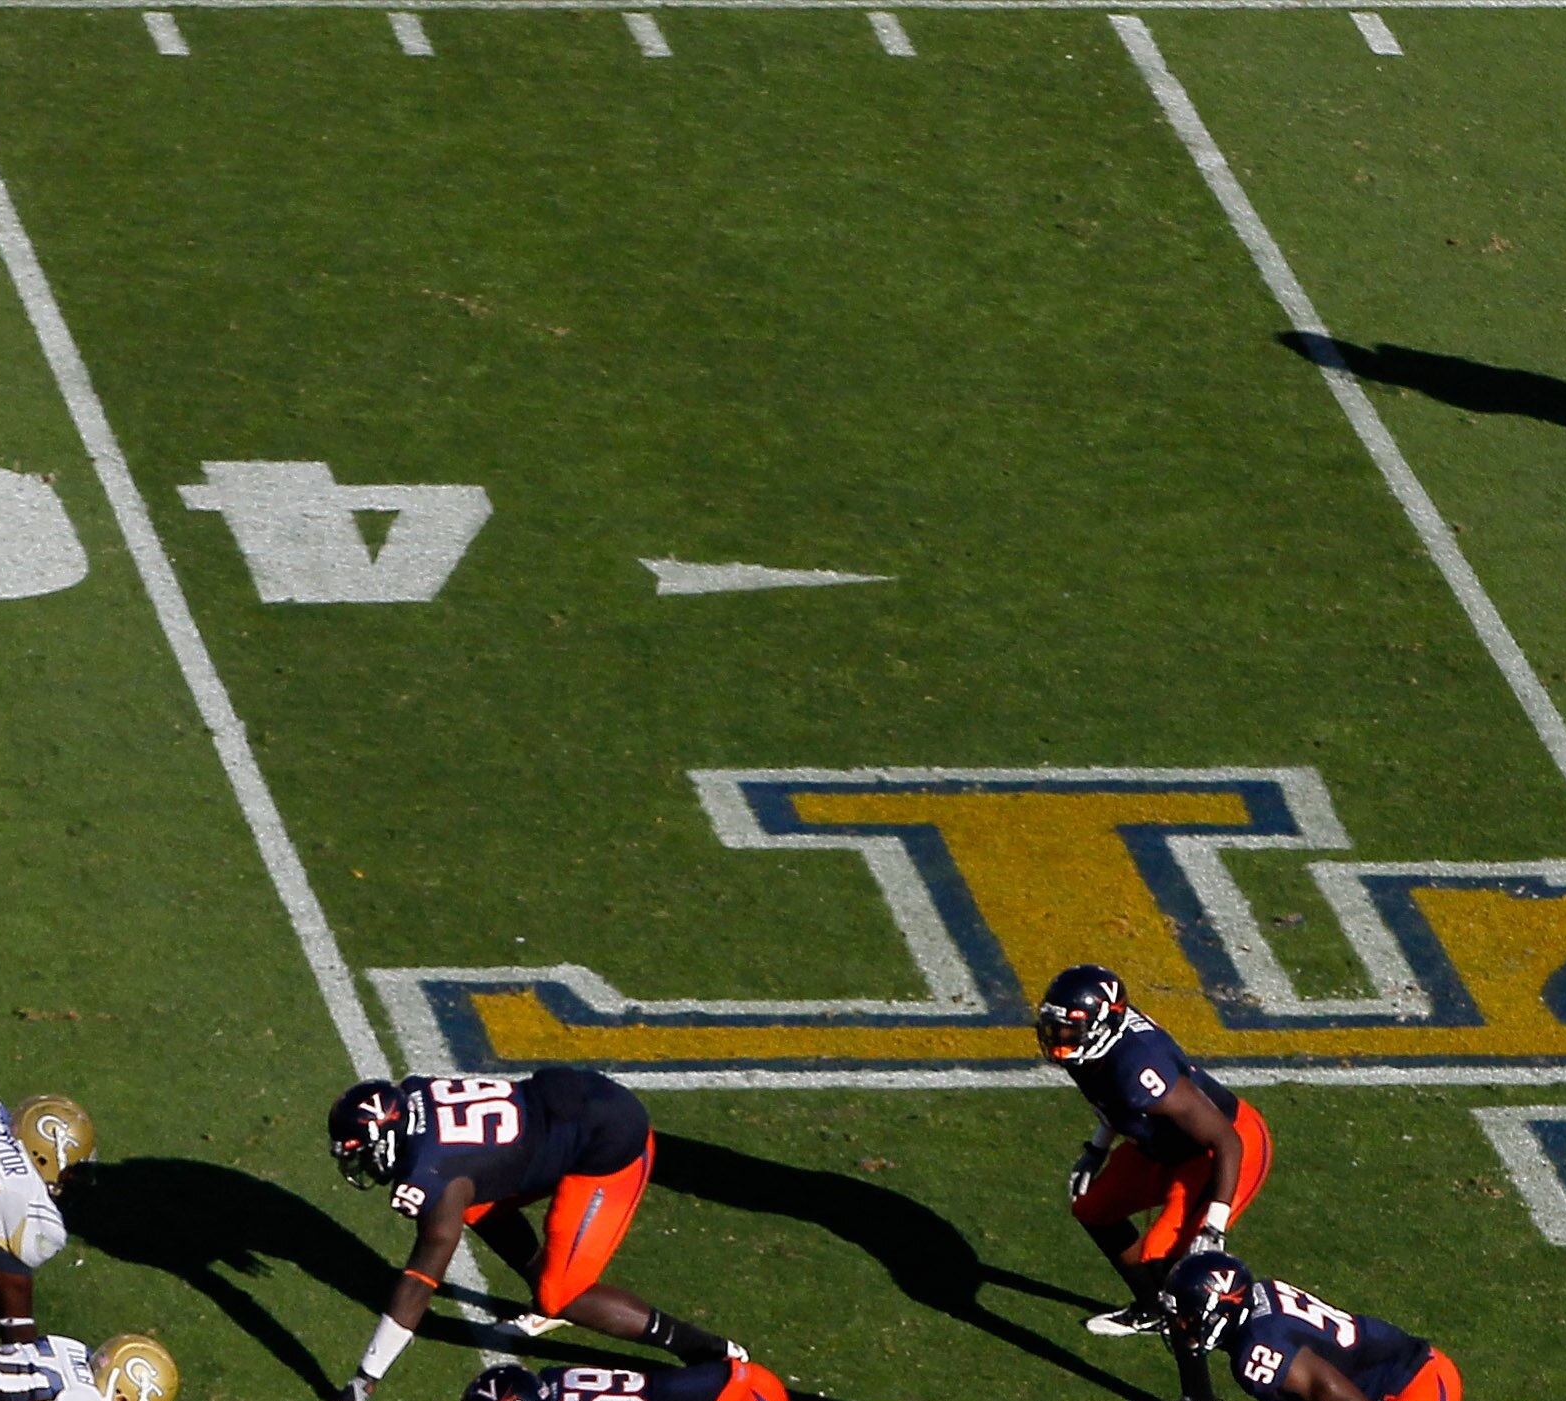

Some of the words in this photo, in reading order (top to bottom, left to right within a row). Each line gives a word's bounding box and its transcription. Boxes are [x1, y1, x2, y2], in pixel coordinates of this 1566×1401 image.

[1138, 1067, 1168, 1098] 9
[430, 1078, 521, 1145] 56
[391, 1183, 426, 1217] 56
[1244, 1344, 1283, 1385] 52
